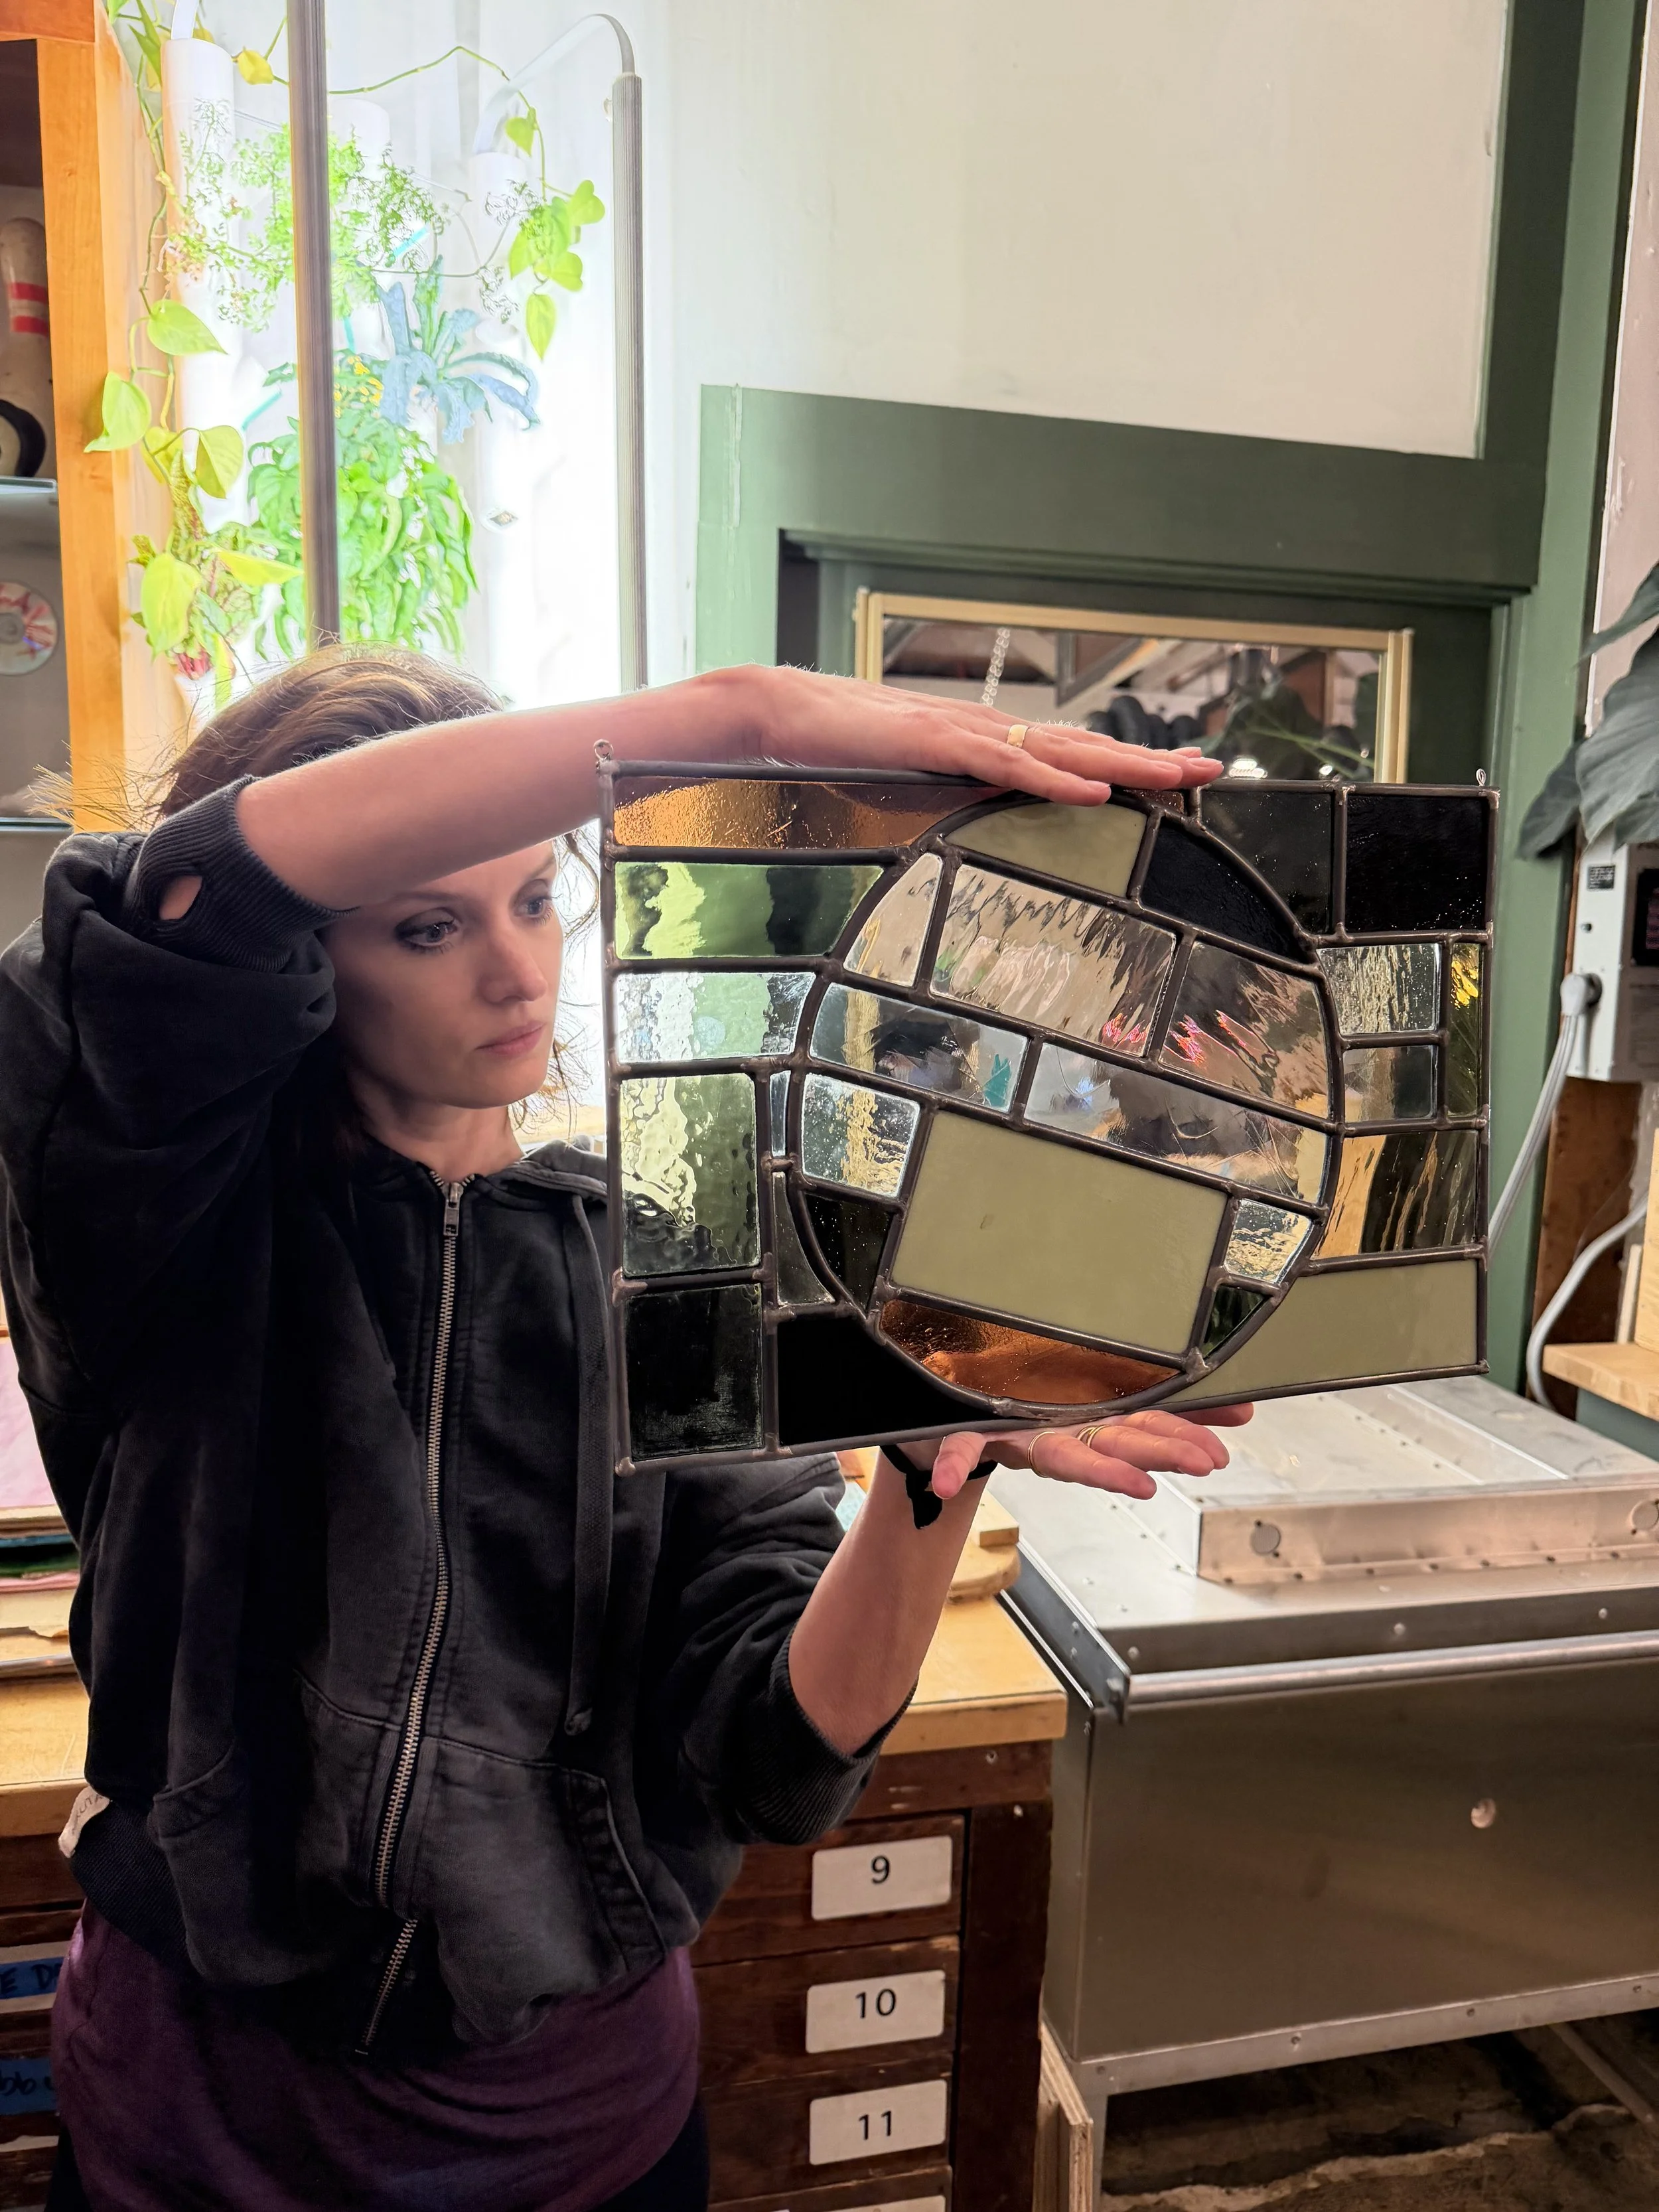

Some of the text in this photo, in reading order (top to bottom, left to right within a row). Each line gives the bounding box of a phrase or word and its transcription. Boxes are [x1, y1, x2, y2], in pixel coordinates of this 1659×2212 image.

[871, 1856, 890, 1883] 9
[855, 1988, 896, 2018] 10
[859, 2110, 891, 2140] 11
